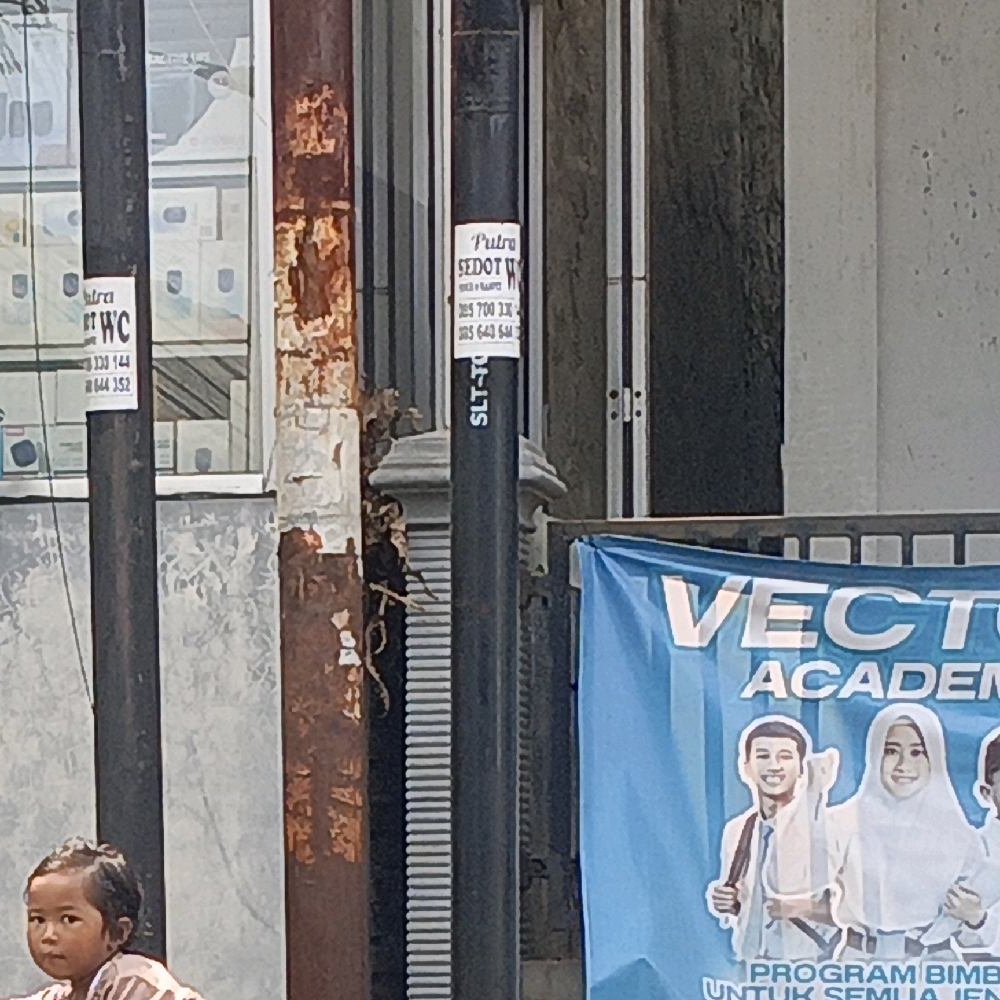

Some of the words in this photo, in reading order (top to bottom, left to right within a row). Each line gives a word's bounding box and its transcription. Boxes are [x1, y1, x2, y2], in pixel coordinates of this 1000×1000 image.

[471, 232, 516, 252] Putra
[458, 257, 502, 277] SEDOT
[100, 310, 130, 344] WC
[661, 574, 1000, 650] VECT
[749, 963, 918, 985] PROGRAM
